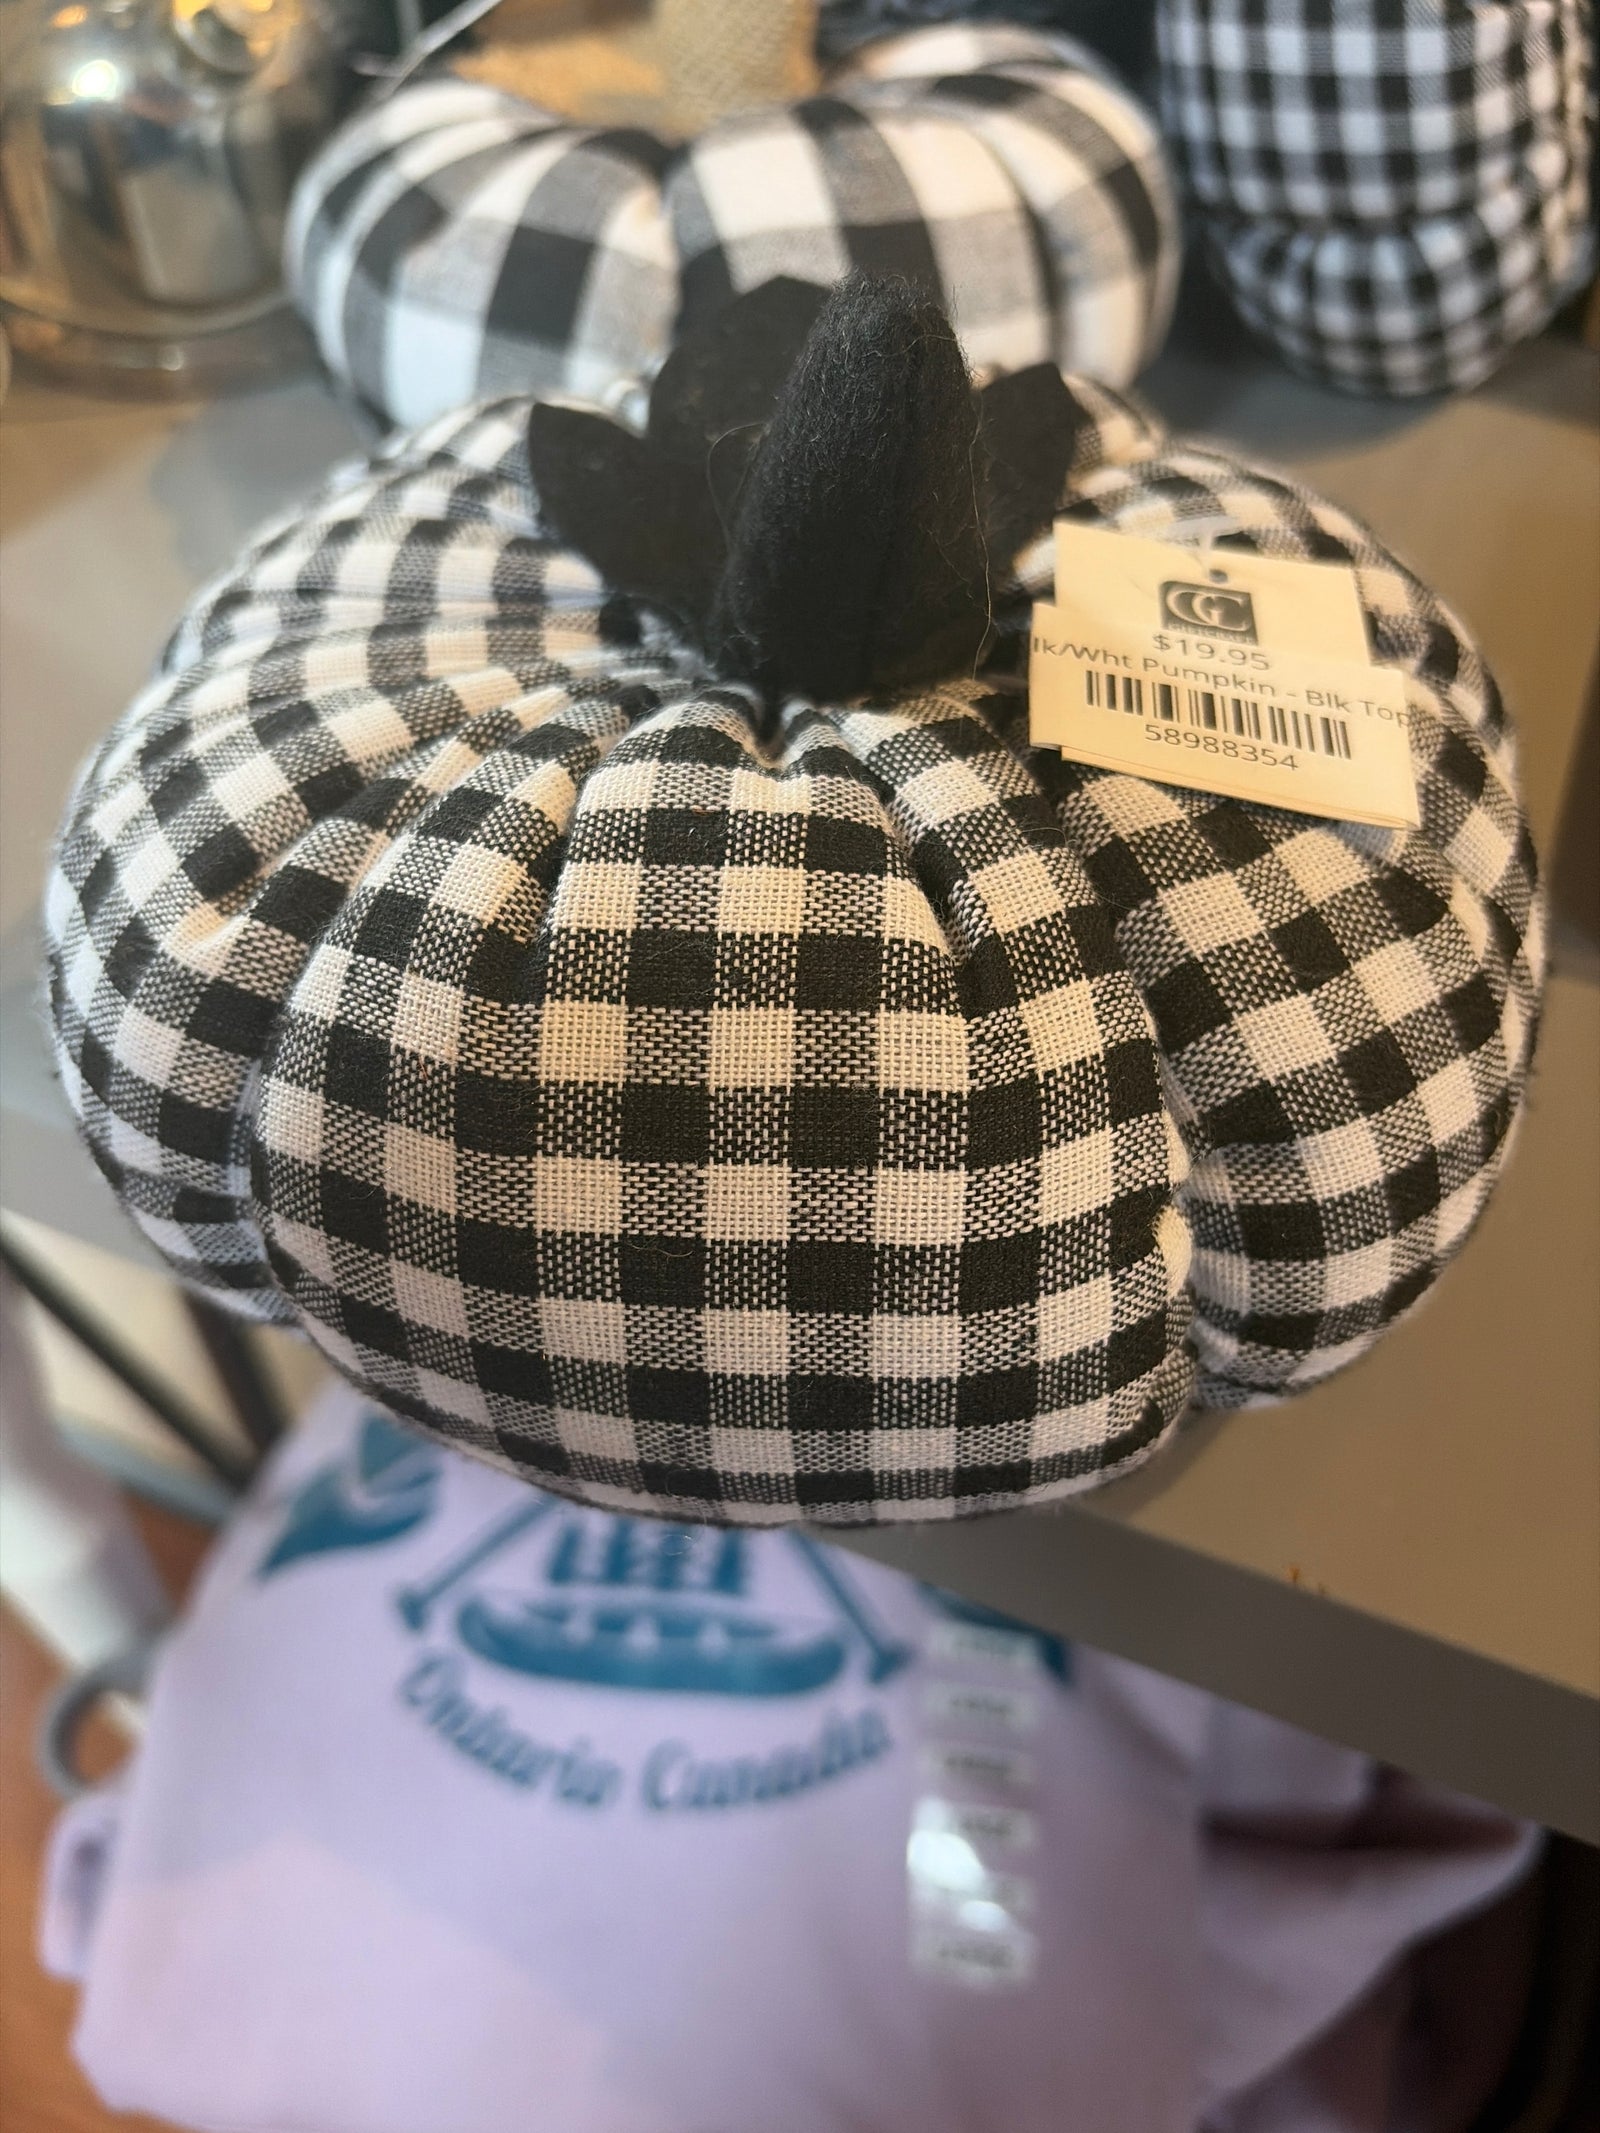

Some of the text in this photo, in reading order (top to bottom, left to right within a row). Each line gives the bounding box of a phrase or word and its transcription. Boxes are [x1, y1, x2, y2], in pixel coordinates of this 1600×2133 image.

[1153, 634, 1270, 671] $19.95
[1142, 657, 1275, 697] Pumpkin
[1305, 690, 1350, 713] Blk
[1359, 700, 1411, 728] Top
[1145, 724, 1299, 771] 58988354
